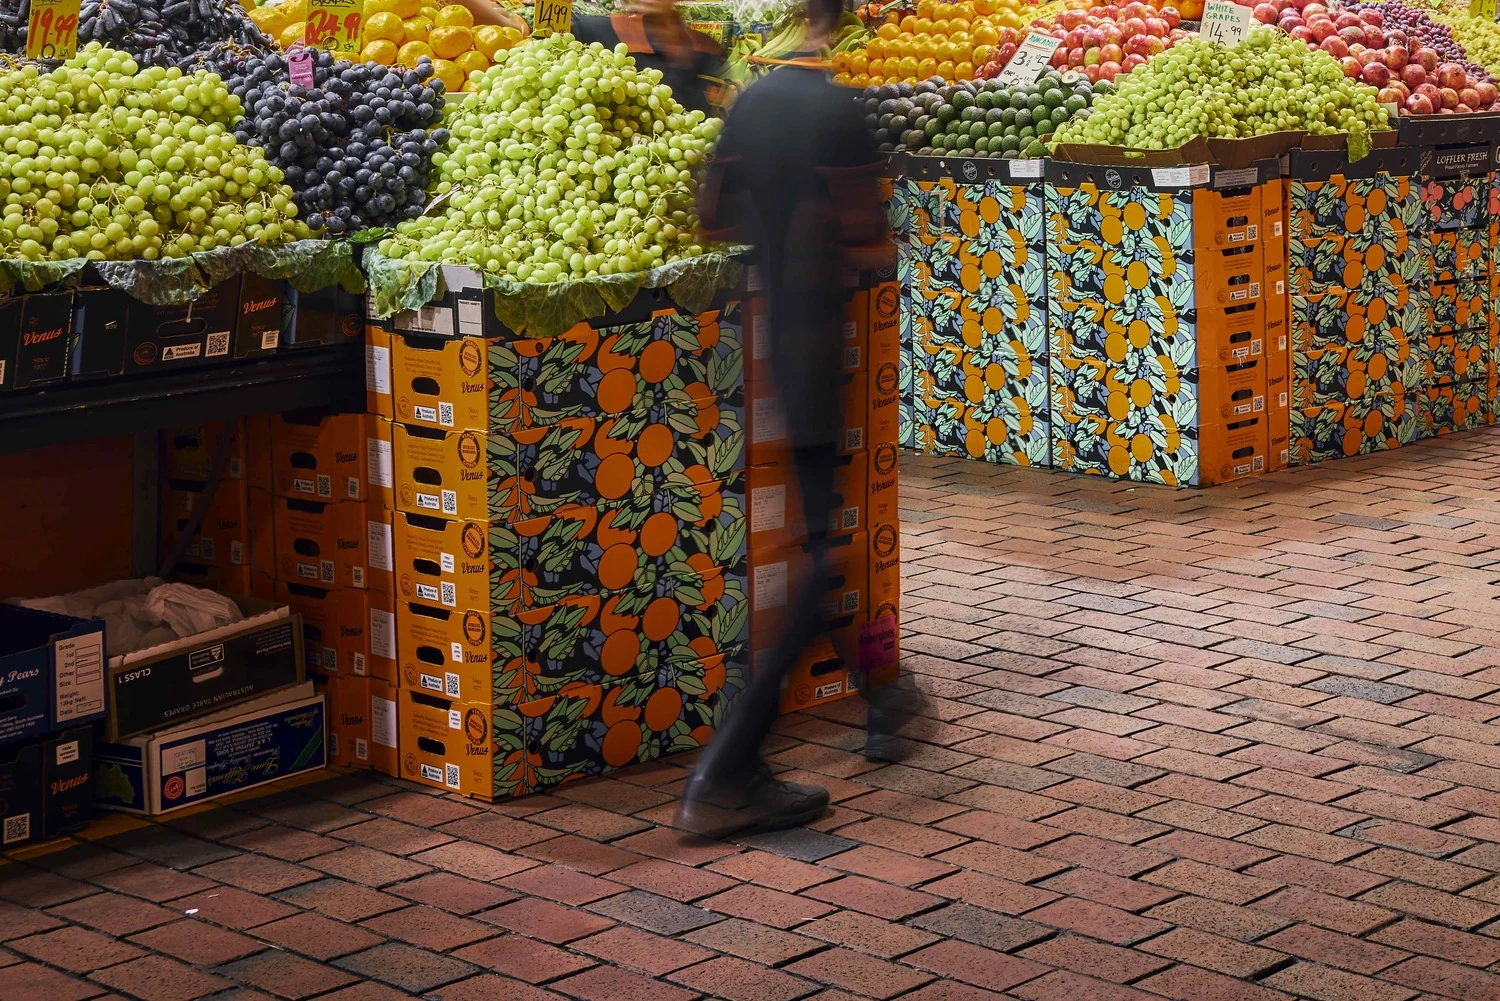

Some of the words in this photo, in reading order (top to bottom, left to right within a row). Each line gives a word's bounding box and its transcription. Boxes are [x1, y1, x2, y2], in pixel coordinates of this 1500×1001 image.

[1026, 4, 1057, 21] PINK
[1207, 3, 1235, 14] WHITE
[1206, 12, 1241, 23] GRAPES
[1029, 35, 1057, 48] AVOCADOS
[1436, 153, 1466, 165] LOFFLER
[1467, 151, 1488, 162] FRESH
[1263, 207, 1280, 218] Venus
[1265, 262, 1282, 274] Venus
[243, 296, 278, 316] Venus
[873, 318, 899, 334] Venus
[1267, 319, 1283, 330] Venus
[23, 327, 63, 346] Venus
[176, 349, 195, 357] Australia
[461, 381, 485, 394] Venus
[1268, 375, 1284, 387] Venus
[872, 395, 897, 410] Venus
[1271, 433, 1288, 447] Venus
[335, 451, 359, 464] Venus
[461, 469, 484, 482] Venus
[871, 478, 895, 494] Venus
[336, 538, 360, 551] Venus
[461, 561, 485, 575] Venus
[874, 559, 900, 575] Venus
[340, 625, 363, 638] Venus
[59, 643, 75, 651] Grade
[464, 651, 488, 664] Venus
[8, 668, 39, 683] Pears
[125, 667, 152, 683] CLASS
[213, 683, 255, 702] AUSTRALIAN
[191, 697, 212, 709] TABLE
[164, 703, 191, 719] GRAPES
[341, 713, 363, 727] Venus
[465, 743, 489, 757] Venus
[51, 772, 89, 796] Venus
